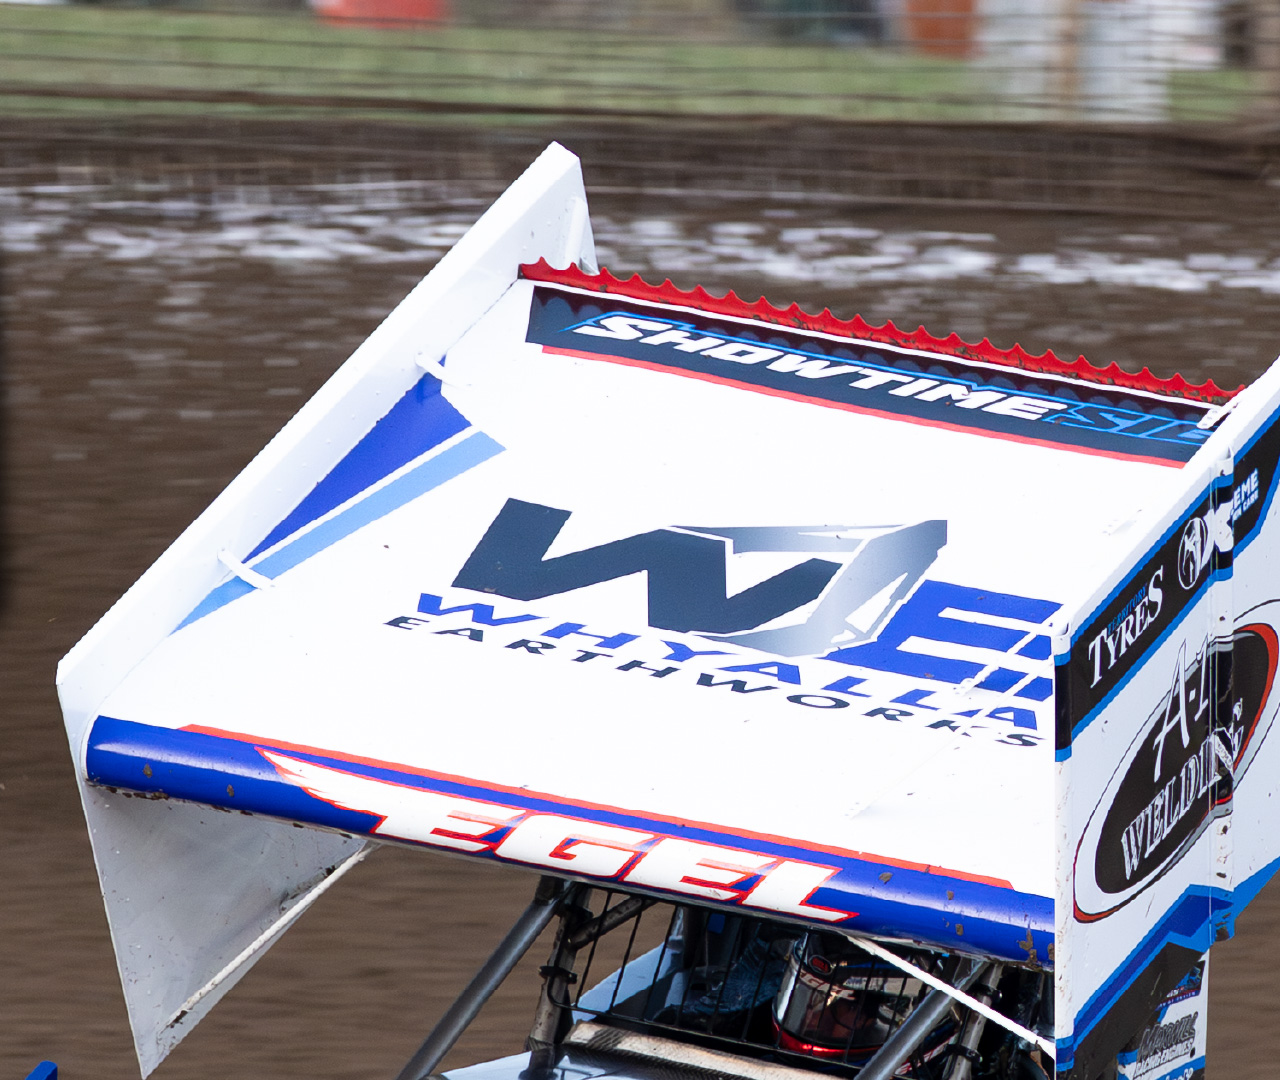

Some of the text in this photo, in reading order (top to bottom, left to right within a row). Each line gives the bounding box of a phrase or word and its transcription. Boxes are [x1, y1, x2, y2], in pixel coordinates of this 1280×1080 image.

[574, 316, 1068, 421] SHOWTIME
[383, 615, 1046, 747] EARTHWORKS
[417, 593, 1037, 730] WHYALLA
[1089, 565, 1163, 688] TYRES
[320, 780, 859, 922] EGEL
